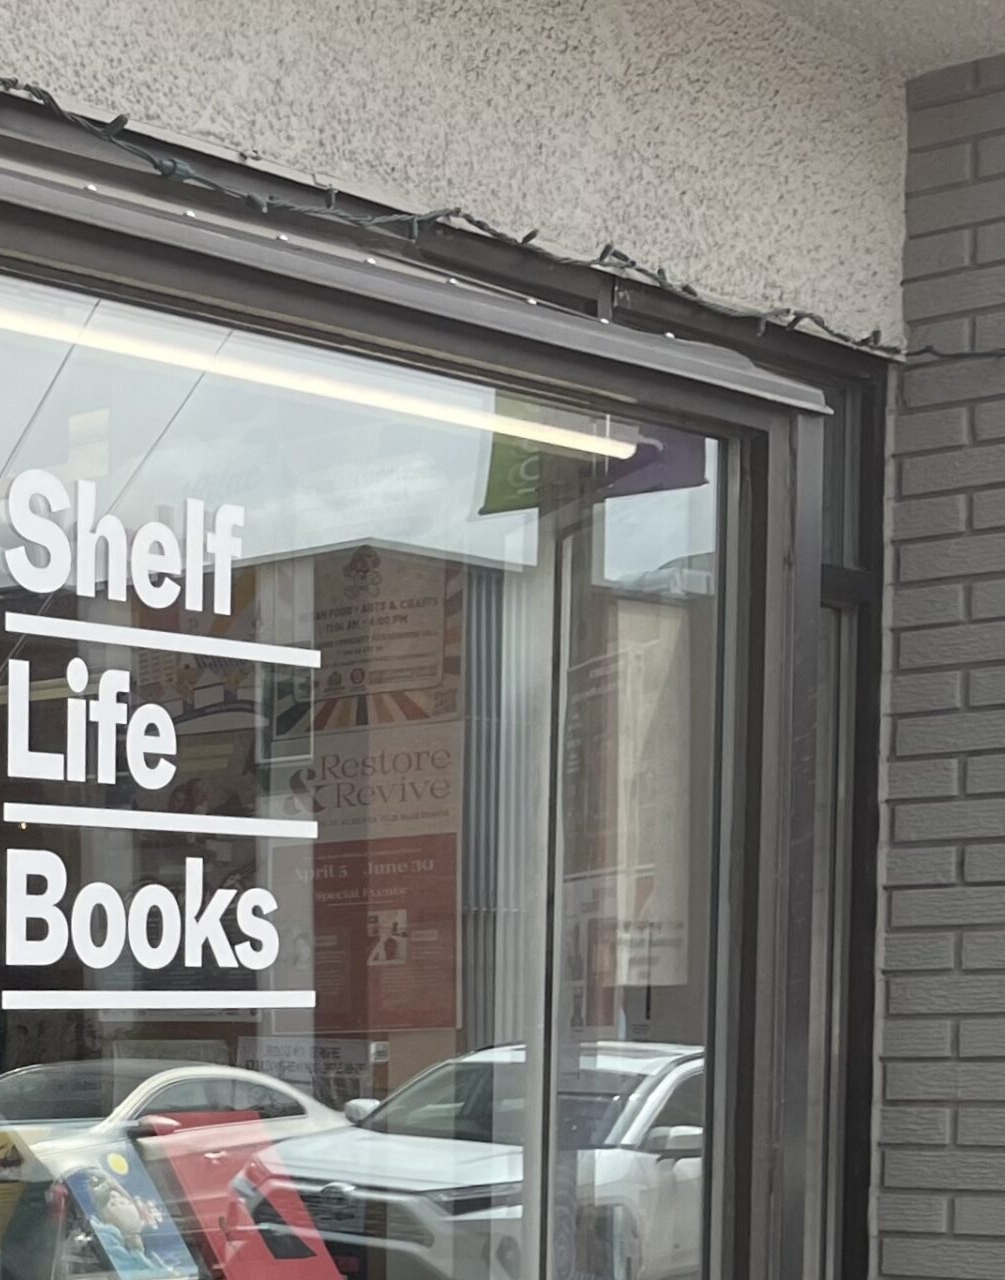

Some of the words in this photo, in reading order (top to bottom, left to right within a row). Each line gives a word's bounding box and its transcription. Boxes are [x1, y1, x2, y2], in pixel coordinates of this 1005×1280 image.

[4, 468, 245, 616] Shelf
[7, 656, 178, 790] Life
[321, 750, 452, 781] Restore
[283, 768, 325, 815] &
[336, 776, 452, 808] Revive
[5, 848, 280, 971] Books
[293, 864, 334, 882] April
[338, 864, 348, 878] 5
[363, 860, 408, 876] June
